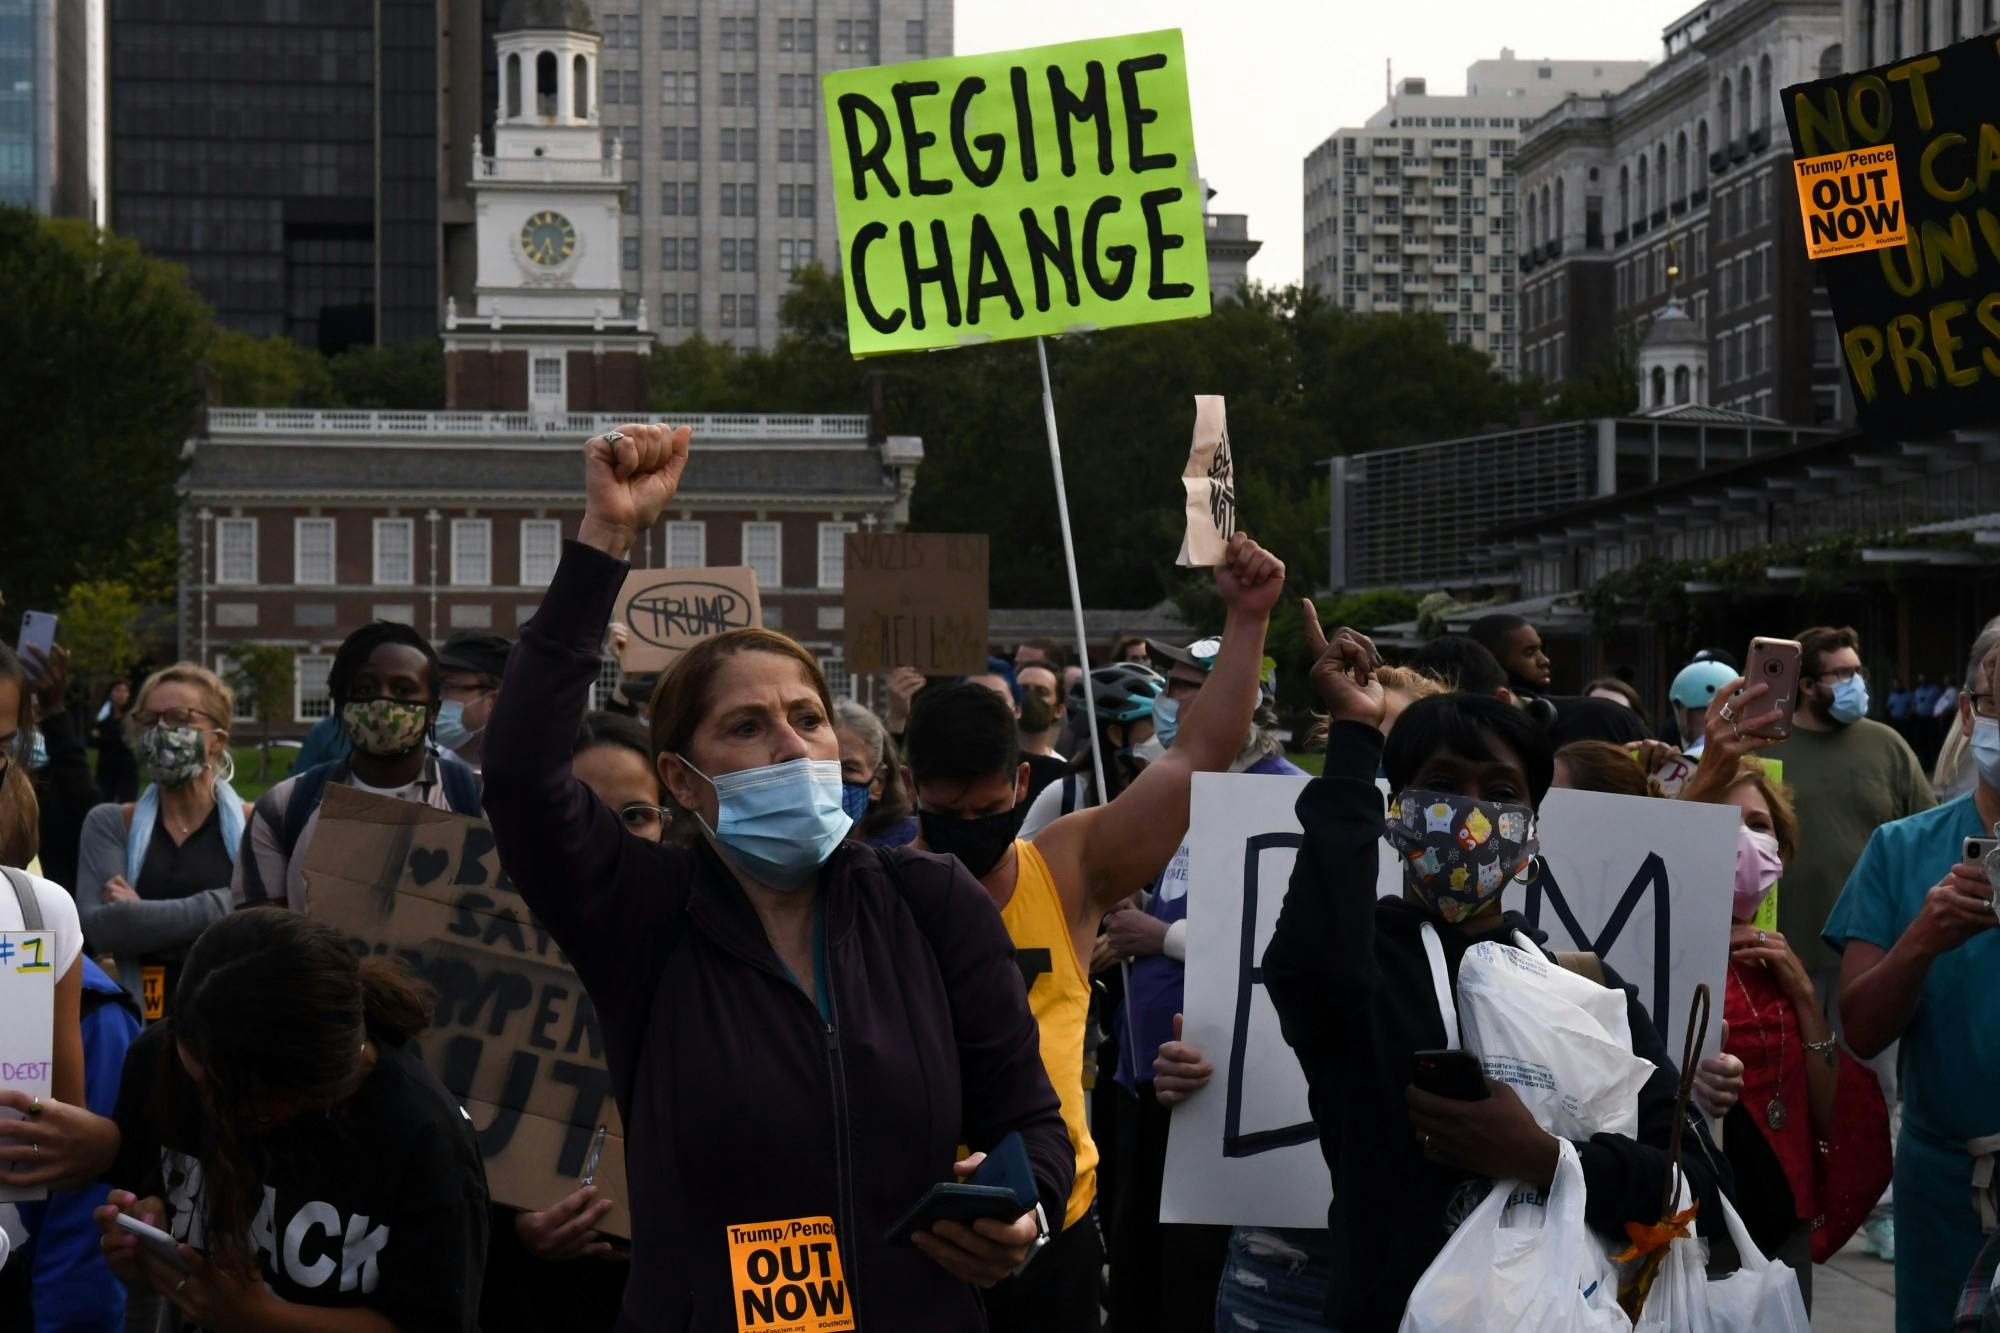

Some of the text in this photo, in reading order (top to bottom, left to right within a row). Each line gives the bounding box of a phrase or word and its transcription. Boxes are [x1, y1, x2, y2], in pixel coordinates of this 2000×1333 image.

[838, 54, 1177, 200] REGIME
[1795, 56, 1941, 156] NOT
[1797, 150, 1895, 176] Trump/Pence
[1812, 169, 1888, 210] OUT
[1809, 200, 1900, 245] NOW
[851, 188, 1194, 334] CHANGE
[638, 594, 736, 637] TRUMP
[2, 1062, 50, 1081] DEBT
[160, 1144, 391, 1295] BACK
[746, 1243, 832, 1285] OUT
[742, 1280, 844, 1325] NOW
